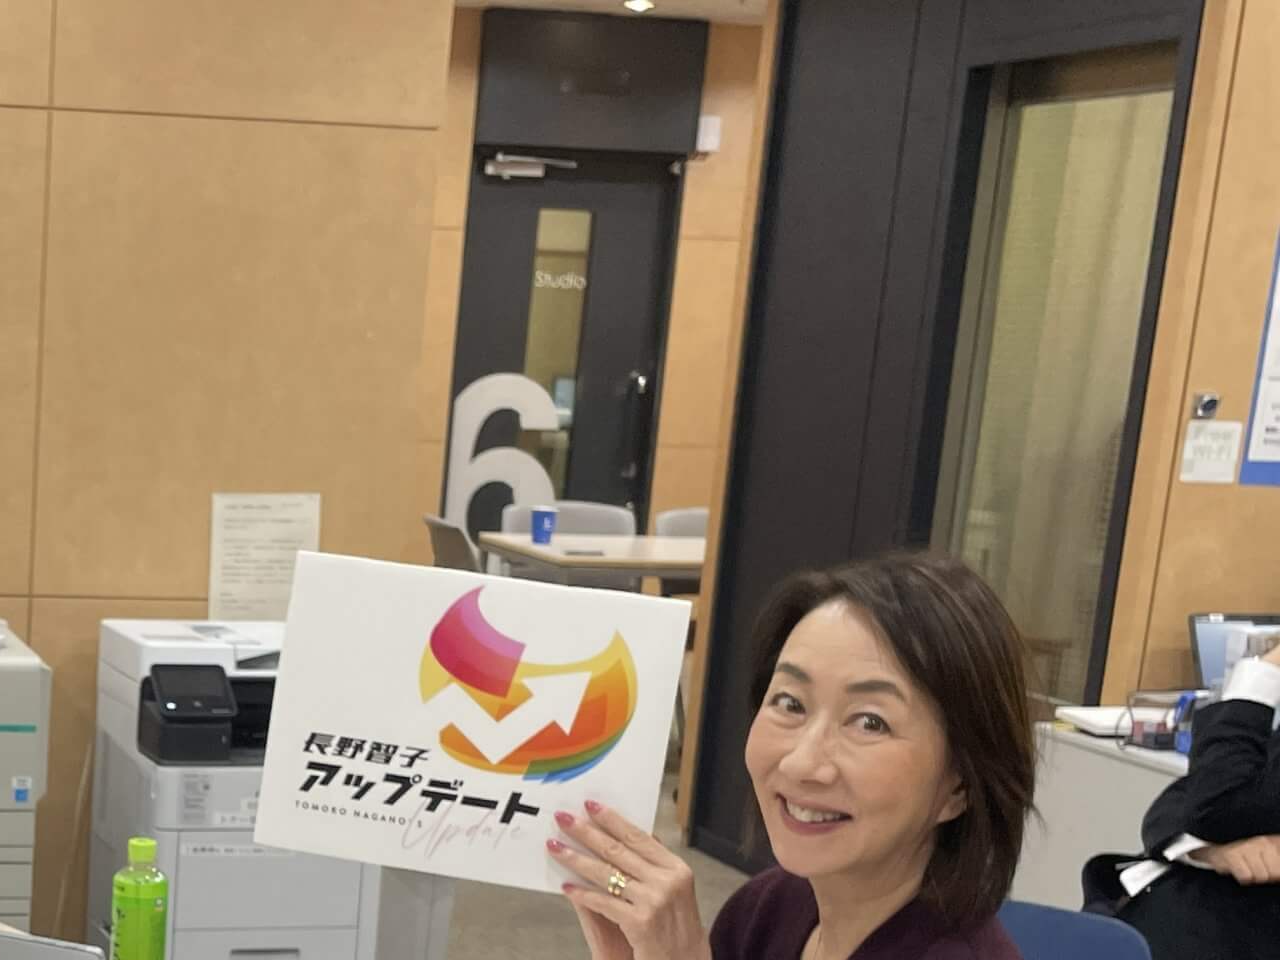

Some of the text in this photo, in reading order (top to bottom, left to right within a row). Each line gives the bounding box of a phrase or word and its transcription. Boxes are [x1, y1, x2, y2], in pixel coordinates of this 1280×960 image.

[534, 270, 587, 290] Studio
[444, 371, 560, 540] 6
[303, 731, 431, 769] 長野智子
[294, 799, 348, 816] TOMOKO
[299, 760, 540, 825] アップデート
